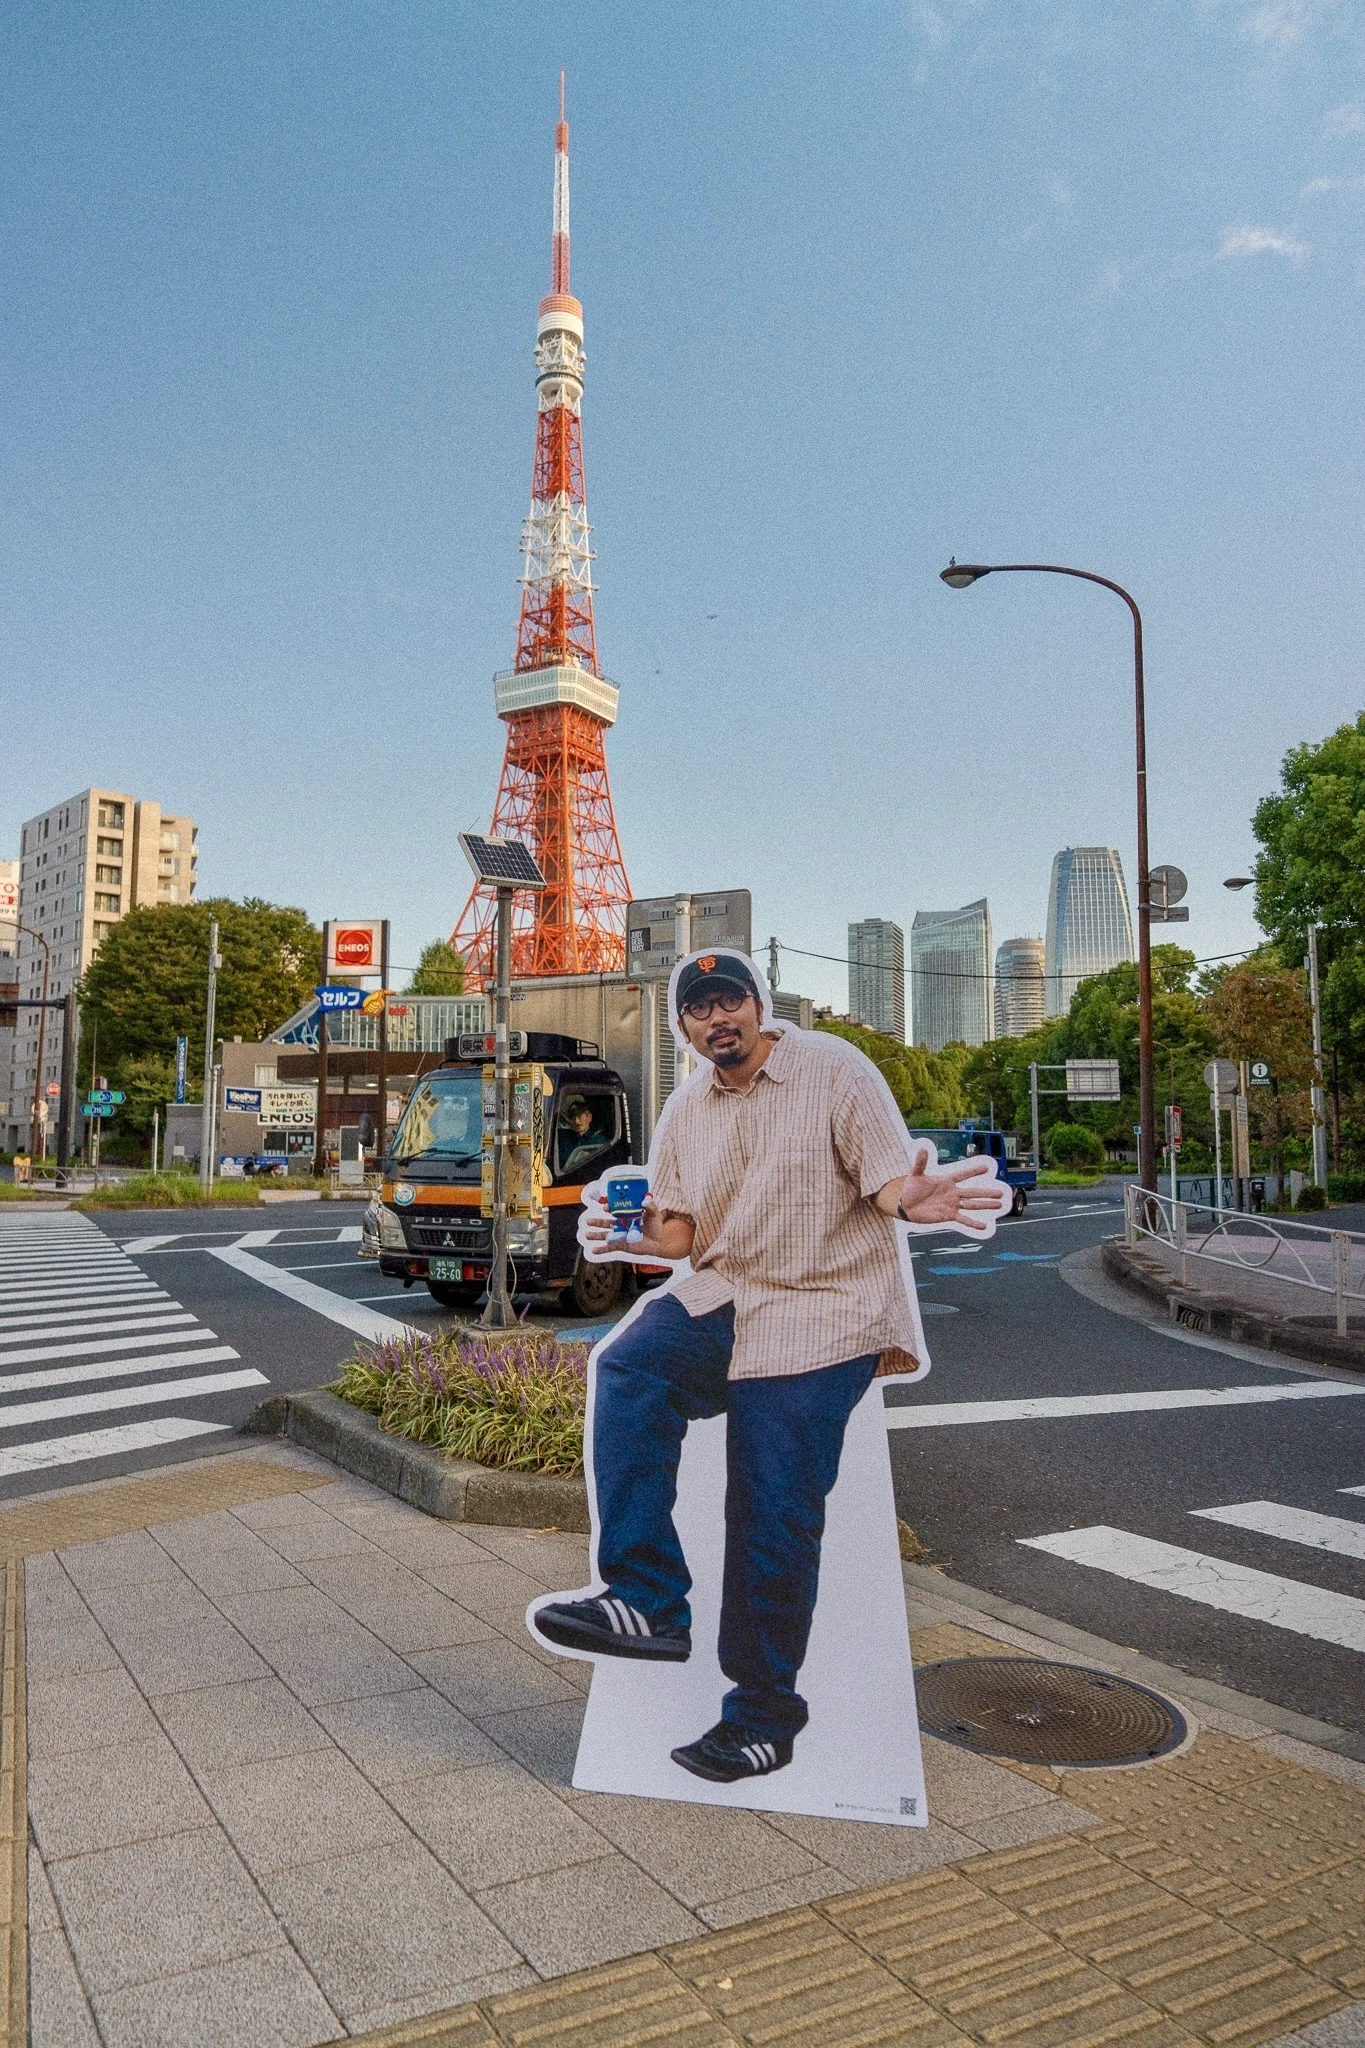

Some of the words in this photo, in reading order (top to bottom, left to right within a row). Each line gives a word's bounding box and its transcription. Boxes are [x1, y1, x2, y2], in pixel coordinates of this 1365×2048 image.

[338, 943, 370, 952] ENEOS
[321, 991, 360, 1006] セルフ
[259, 1113, 314, 1123] ENEOS
[414, 1216, 482, 1226] FUSO
